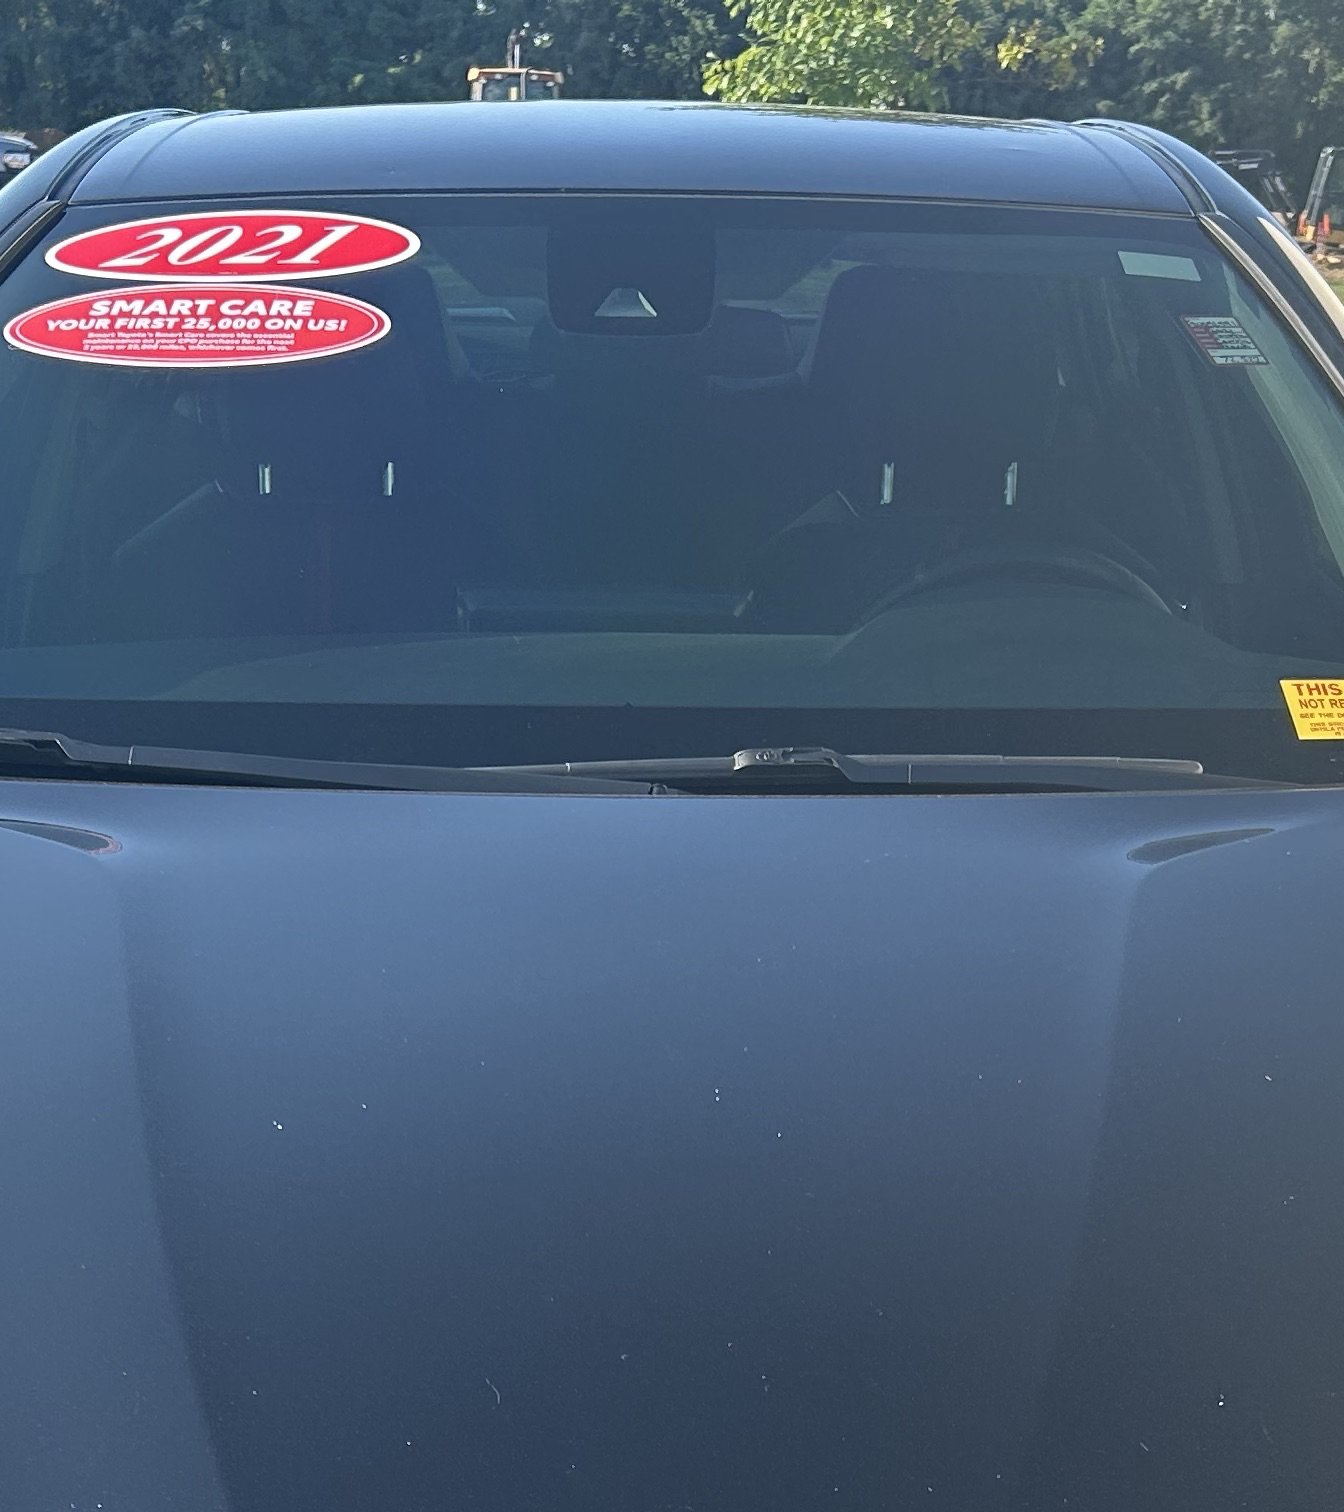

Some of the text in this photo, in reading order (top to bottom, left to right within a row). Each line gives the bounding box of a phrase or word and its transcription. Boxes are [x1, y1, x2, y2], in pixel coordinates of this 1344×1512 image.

[98, 223, 360, 268] 2021
[88, 299, 316, 317] SMART CARE
[46, 317, 348, 332] YOUR FIRST 25,000 ON US!
[1292, 683, 1343, 697] THIS
[1299, 699, 1325, 709] NOT
